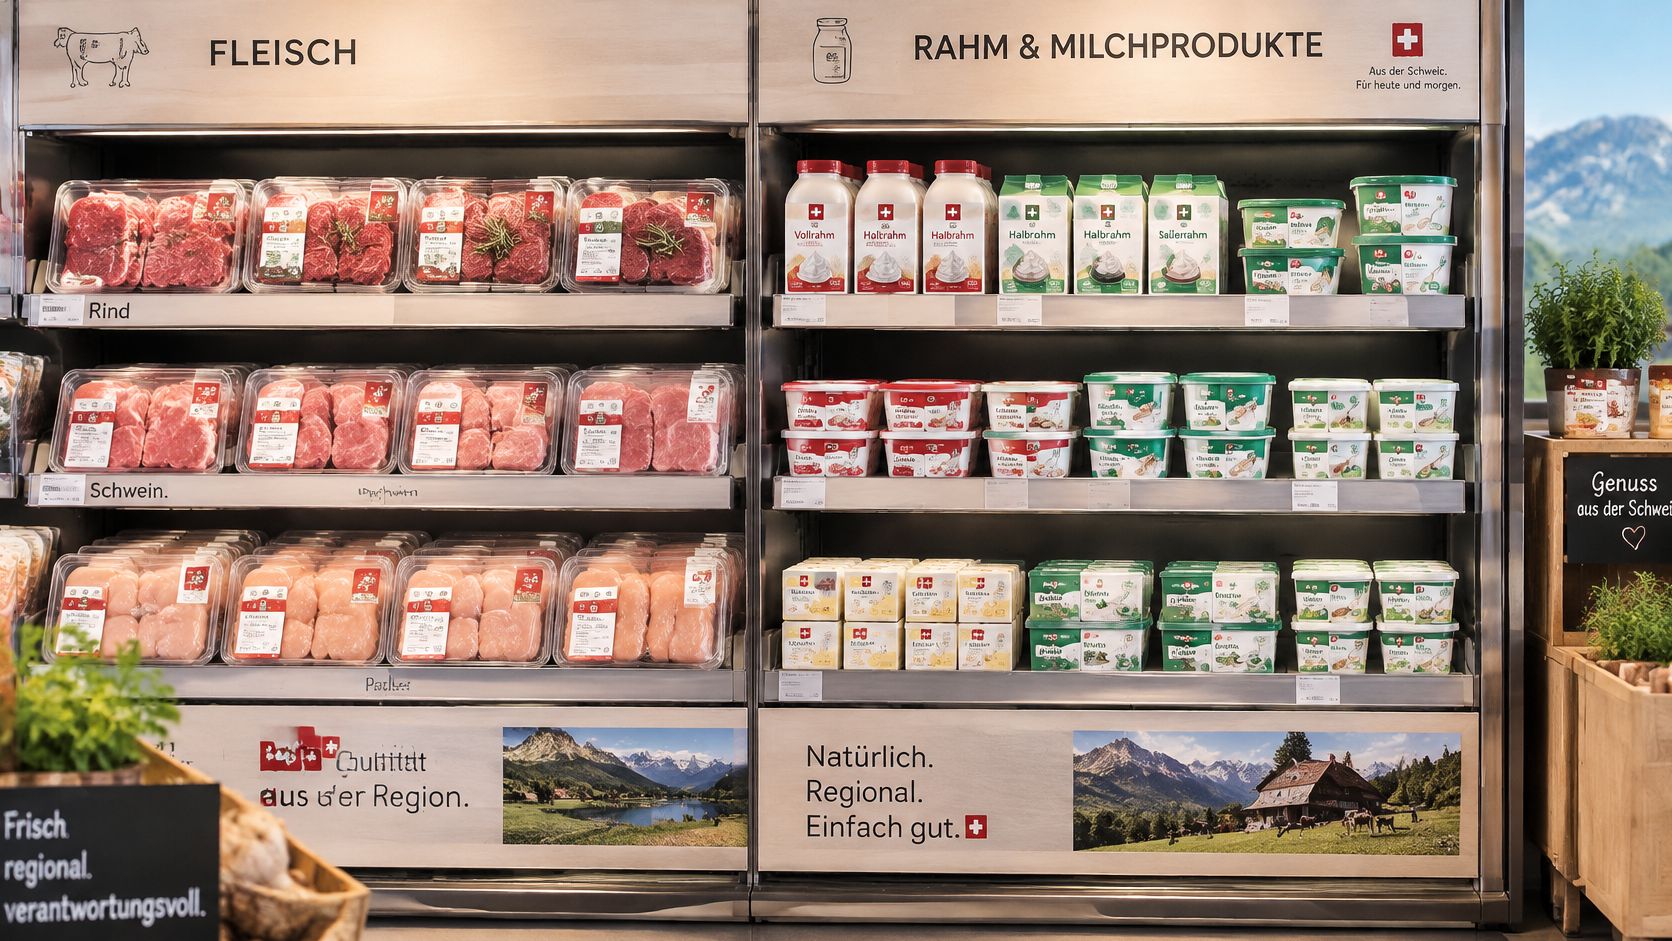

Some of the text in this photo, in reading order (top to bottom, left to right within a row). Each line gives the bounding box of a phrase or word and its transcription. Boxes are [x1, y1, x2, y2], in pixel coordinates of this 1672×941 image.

[210, 39, 356, 66] FLEISCH
[914, 31, 1323, 61] RAHM & MILCHPRODUKTE
[1369, 66, 1387, 76] Aus
[1389, 66, 1405, 76] der
[1374, 80, 1401, 90] heute
[1403, 80, 1421, 90] und
[1424, 82, 1461, 91] morgen.
[89, 302, 130, 319] Rind
[90, 482, 169, 499] Schwein.
[1591, 471, 1658, 497] Genuss
[1577, 504, 1599, 517] aus
[1603, 500, 1625, 517] der
[807, 744, 933, 768] Natürlich.
[373, 784, 469, 814] Region.
[807, 779, 923, 809] Regional.
[807, 814, 960, 845] Einfach gut.
[4, 886, 207, 928] verantwortungsvoll.
